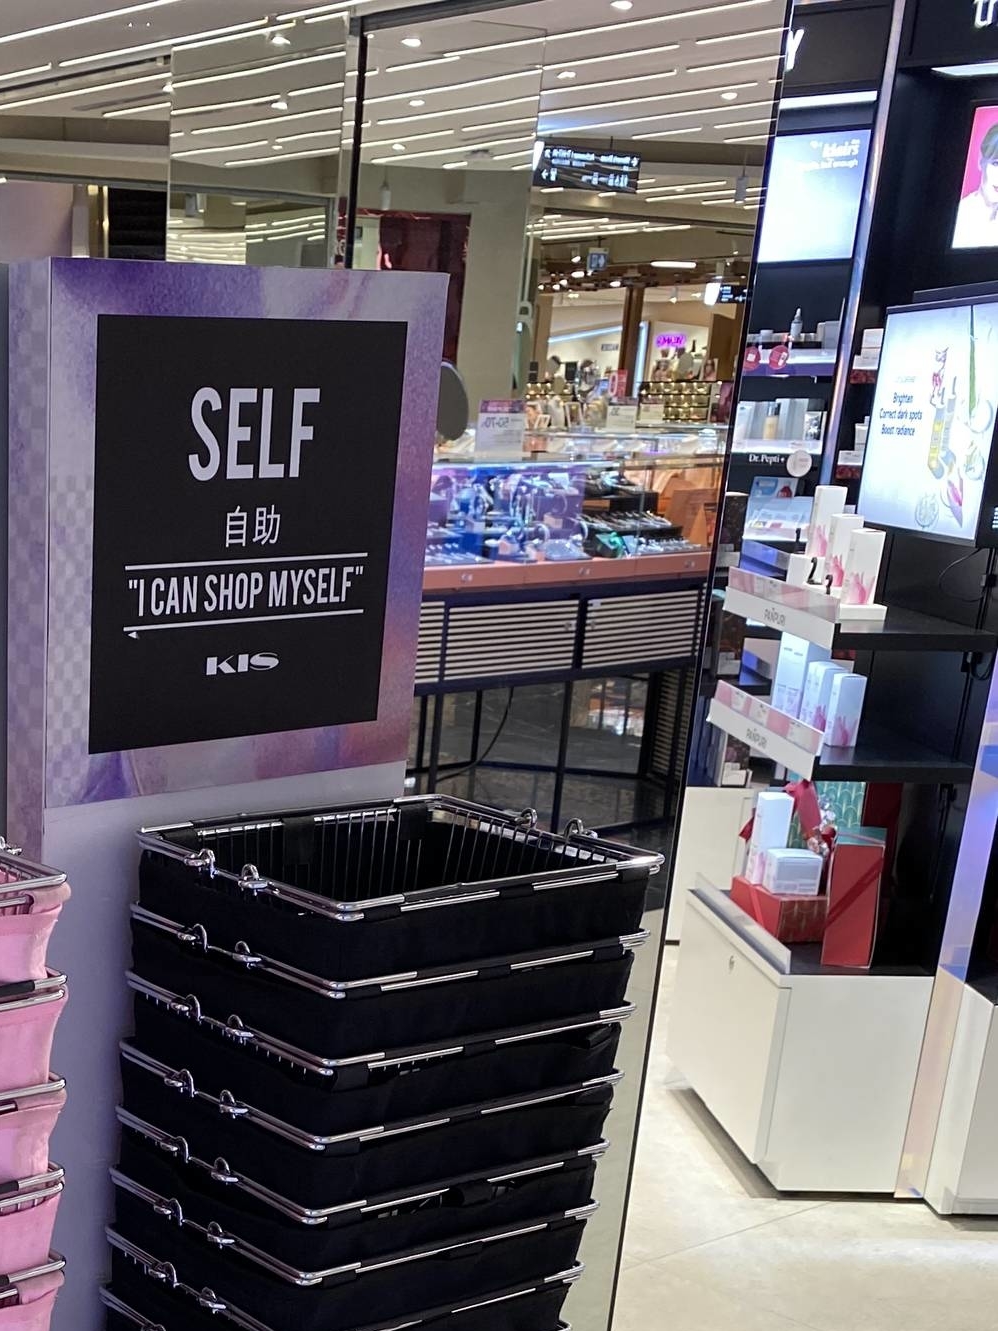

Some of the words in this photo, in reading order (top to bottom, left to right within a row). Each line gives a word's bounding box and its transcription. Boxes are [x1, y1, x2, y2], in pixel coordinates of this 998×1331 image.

[880, 408, 896, 419] Correct
[897, 409, 908, 420] dark
[909, 409, 923, 422] spots
[881, 423, 895, 435] Boost
[188, 386, 321, 482] SELF
[225, 505, 281, 548] 自助
[128, 577, 145, 617] "I
[150, 574, 198, 616] CAN
[204, 571, 261, 613] SHOP
[268, 565, 364, 608] MYSELF"
[206, 651, 280, 676] KIS
